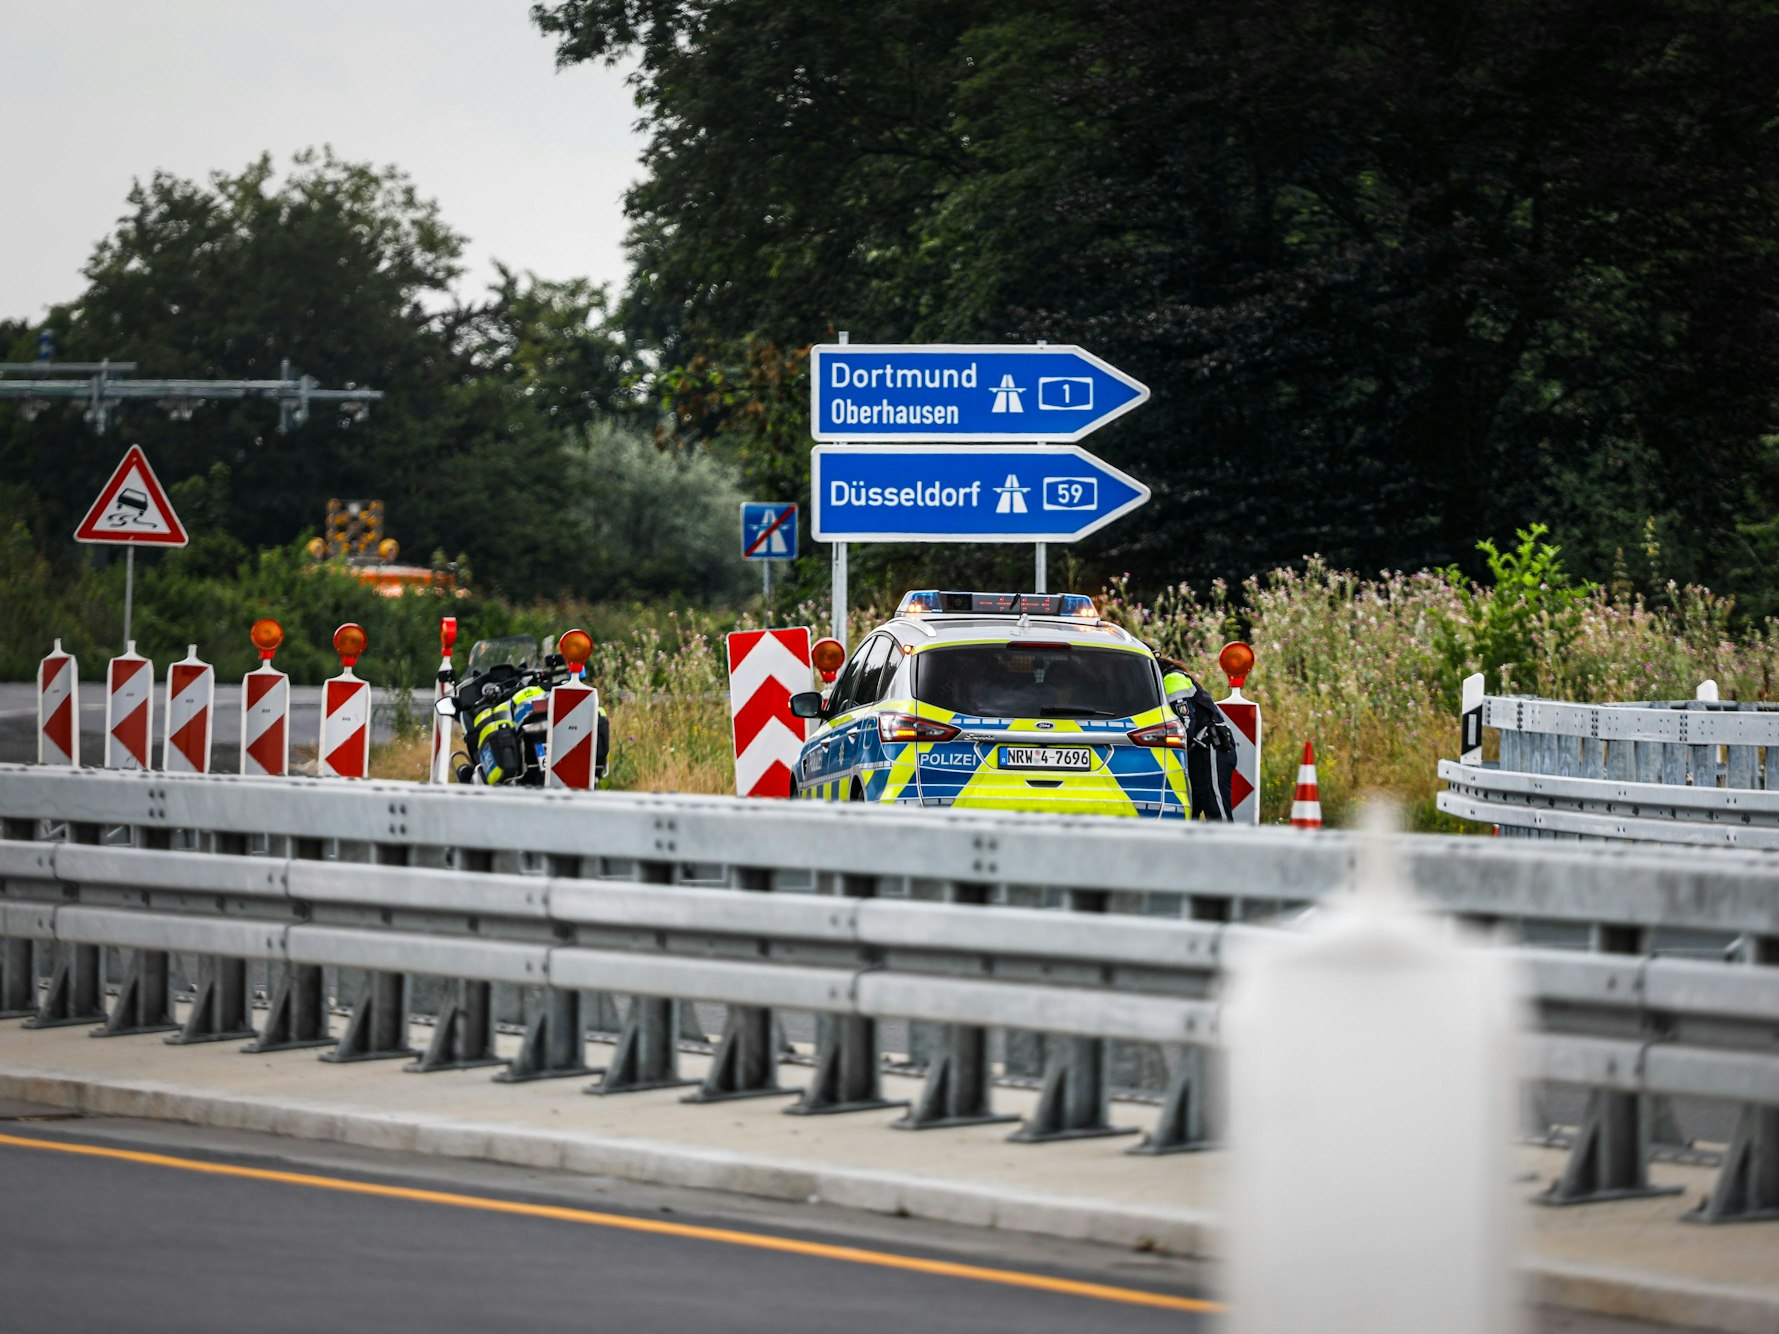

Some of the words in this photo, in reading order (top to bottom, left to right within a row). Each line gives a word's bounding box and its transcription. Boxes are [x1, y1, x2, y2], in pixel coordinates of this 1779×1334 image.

[831, 362, 977, 388] Dortmund
[1062, 384, 1070, 403] 1
[831, 398, 959, 424] Oberhausen
[830, 480, 982, 507] Düsseldorf
[1057, 483, 1083, 504] 59
[919, 753, 977, 766] POLIZEI
[1008, 749, 1033, 764] NRW
[1041, 750, 1089, 765] 4-7696
